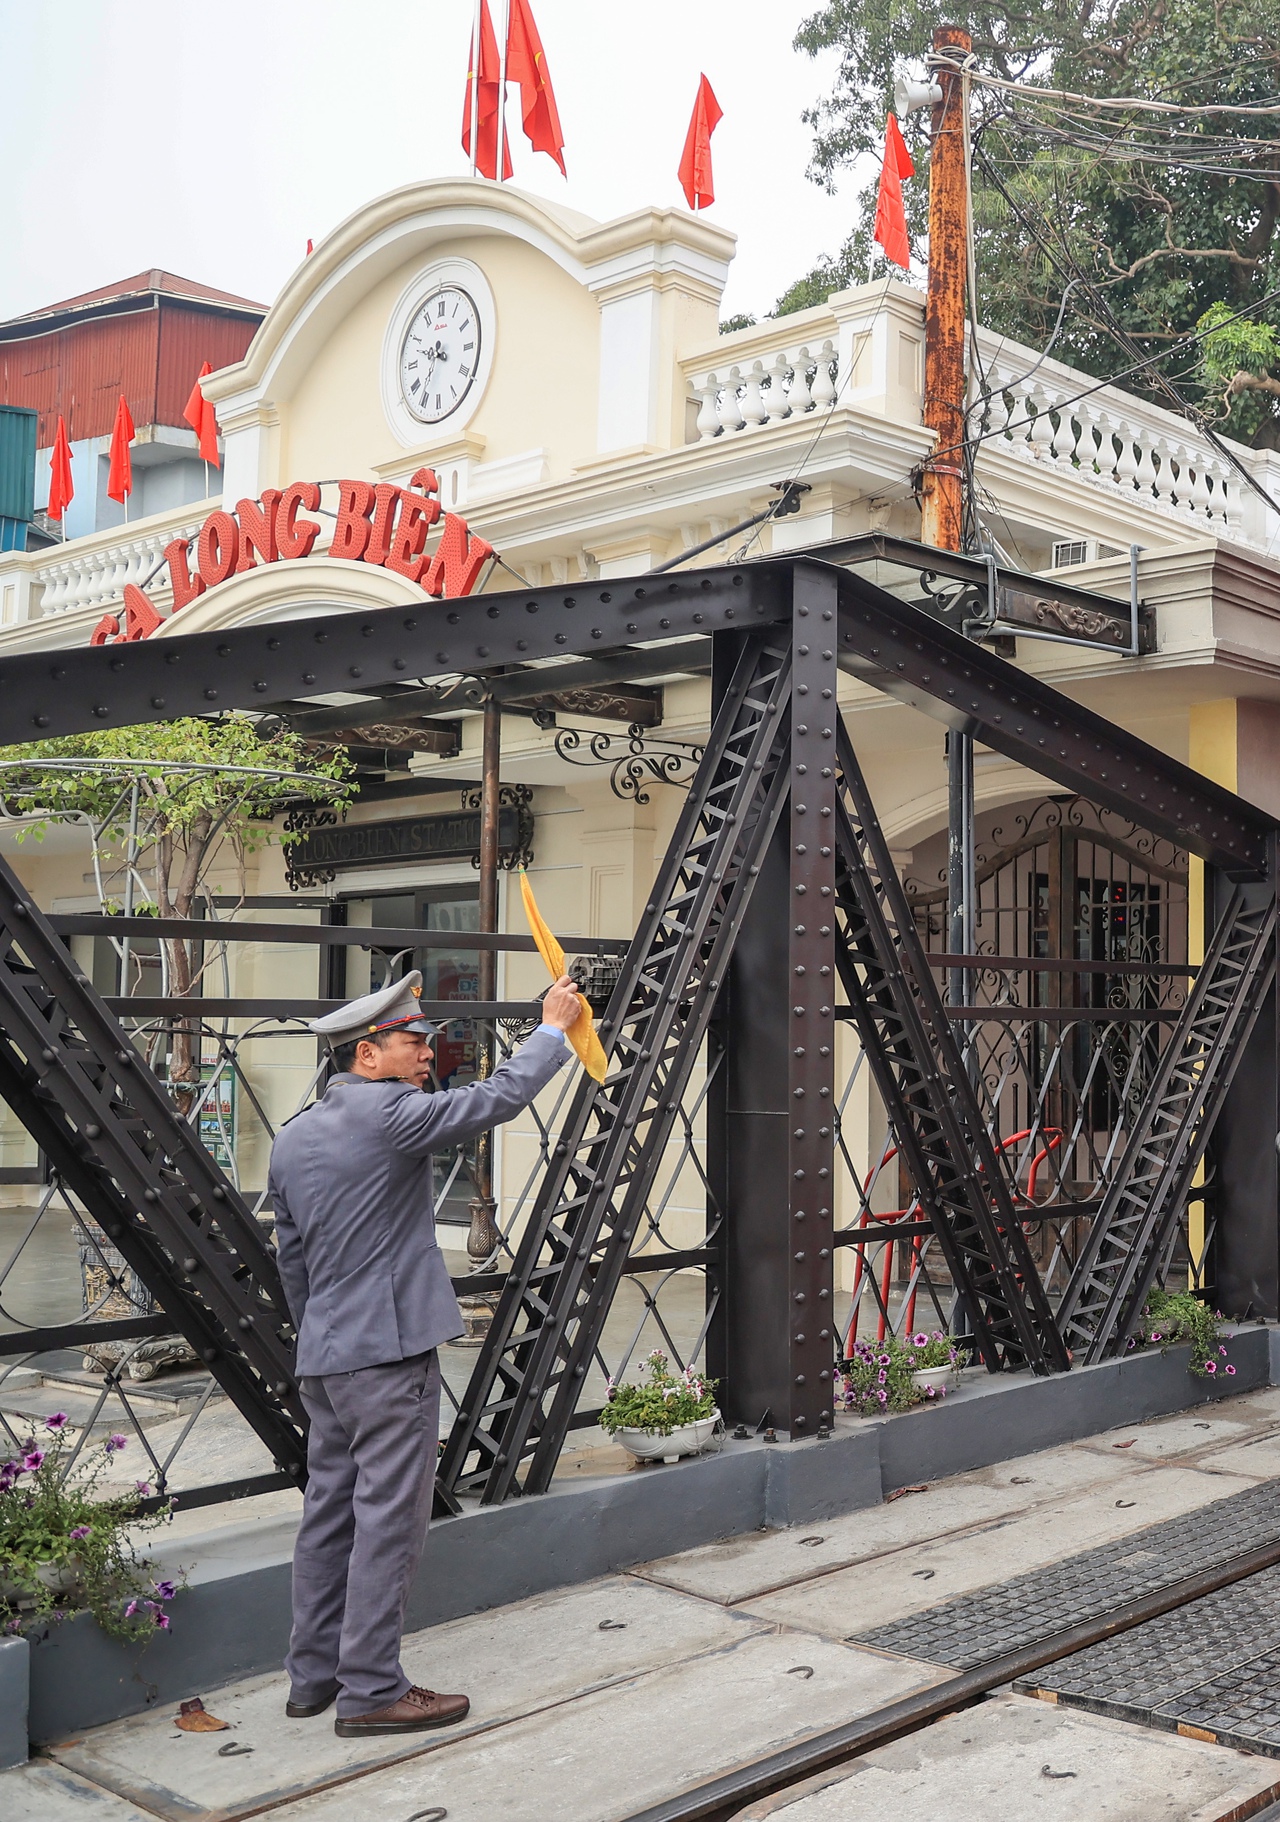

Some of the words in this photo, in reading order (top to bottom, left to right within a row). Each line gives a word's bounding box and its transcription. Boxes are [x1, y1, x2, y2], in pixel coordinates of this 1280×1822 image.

[163, 481, 321, 614] LONG
[328, 467, 493, 599] BIÊN
[410, 817, 481, 851] STATIO
